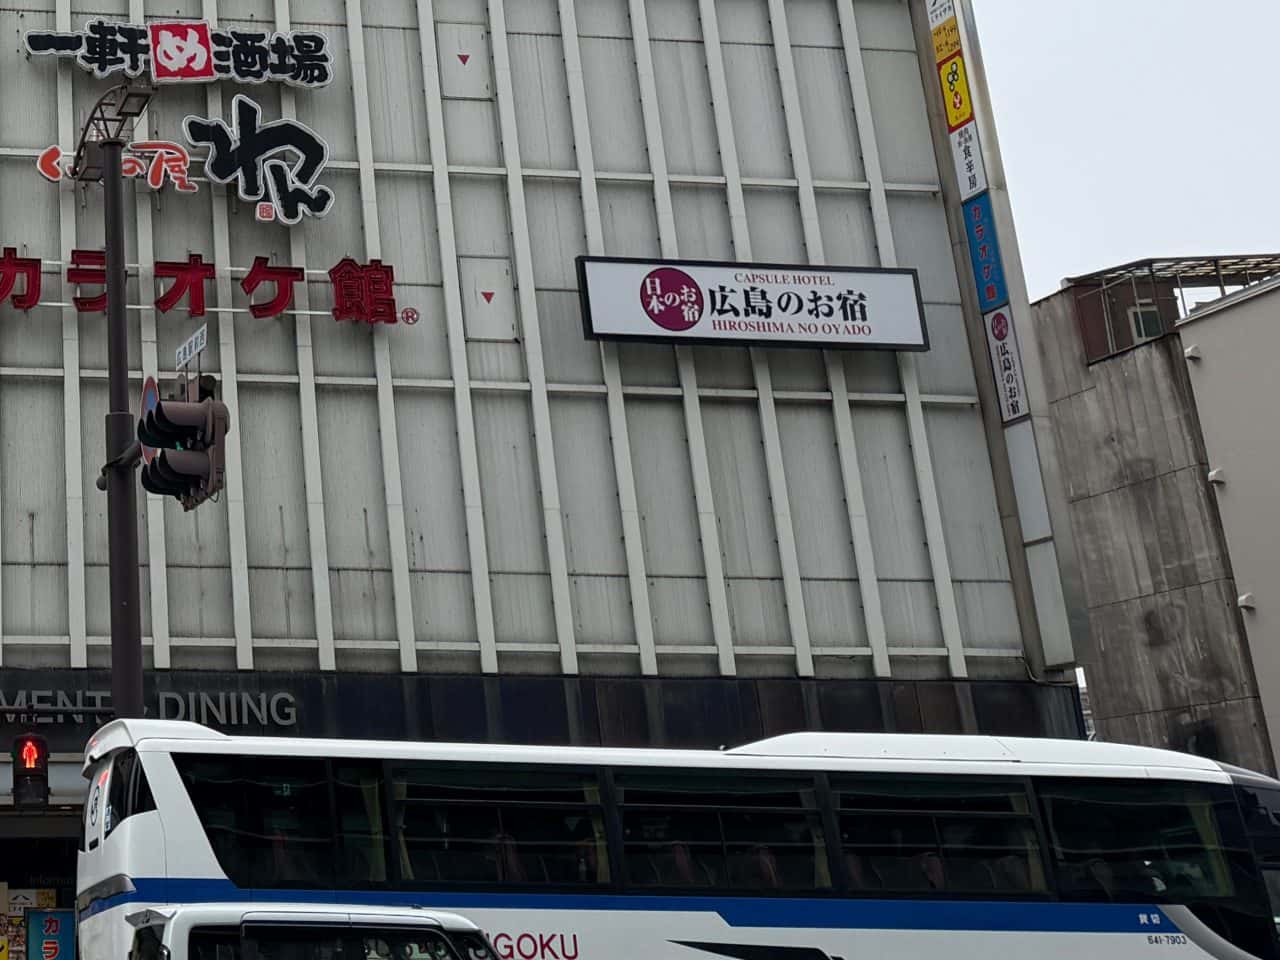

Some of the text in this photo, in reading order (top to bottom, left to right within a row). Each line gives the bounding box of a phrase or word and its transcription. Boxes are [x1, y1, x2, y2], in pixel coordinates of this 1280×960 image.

[25, 18, 331, 86] 一軒め酒場
[183, 94, 334, 225] わん
[734, 272, 835, 287] CAPSULE HOTEL
[708, 285, 869, 323] 広島のお宿
[712, 318, 872, 337] HIROSHIMA NO OYADO
[159, 691, 298, 727] DINING
[486, 932, 578, 960] GOKU
